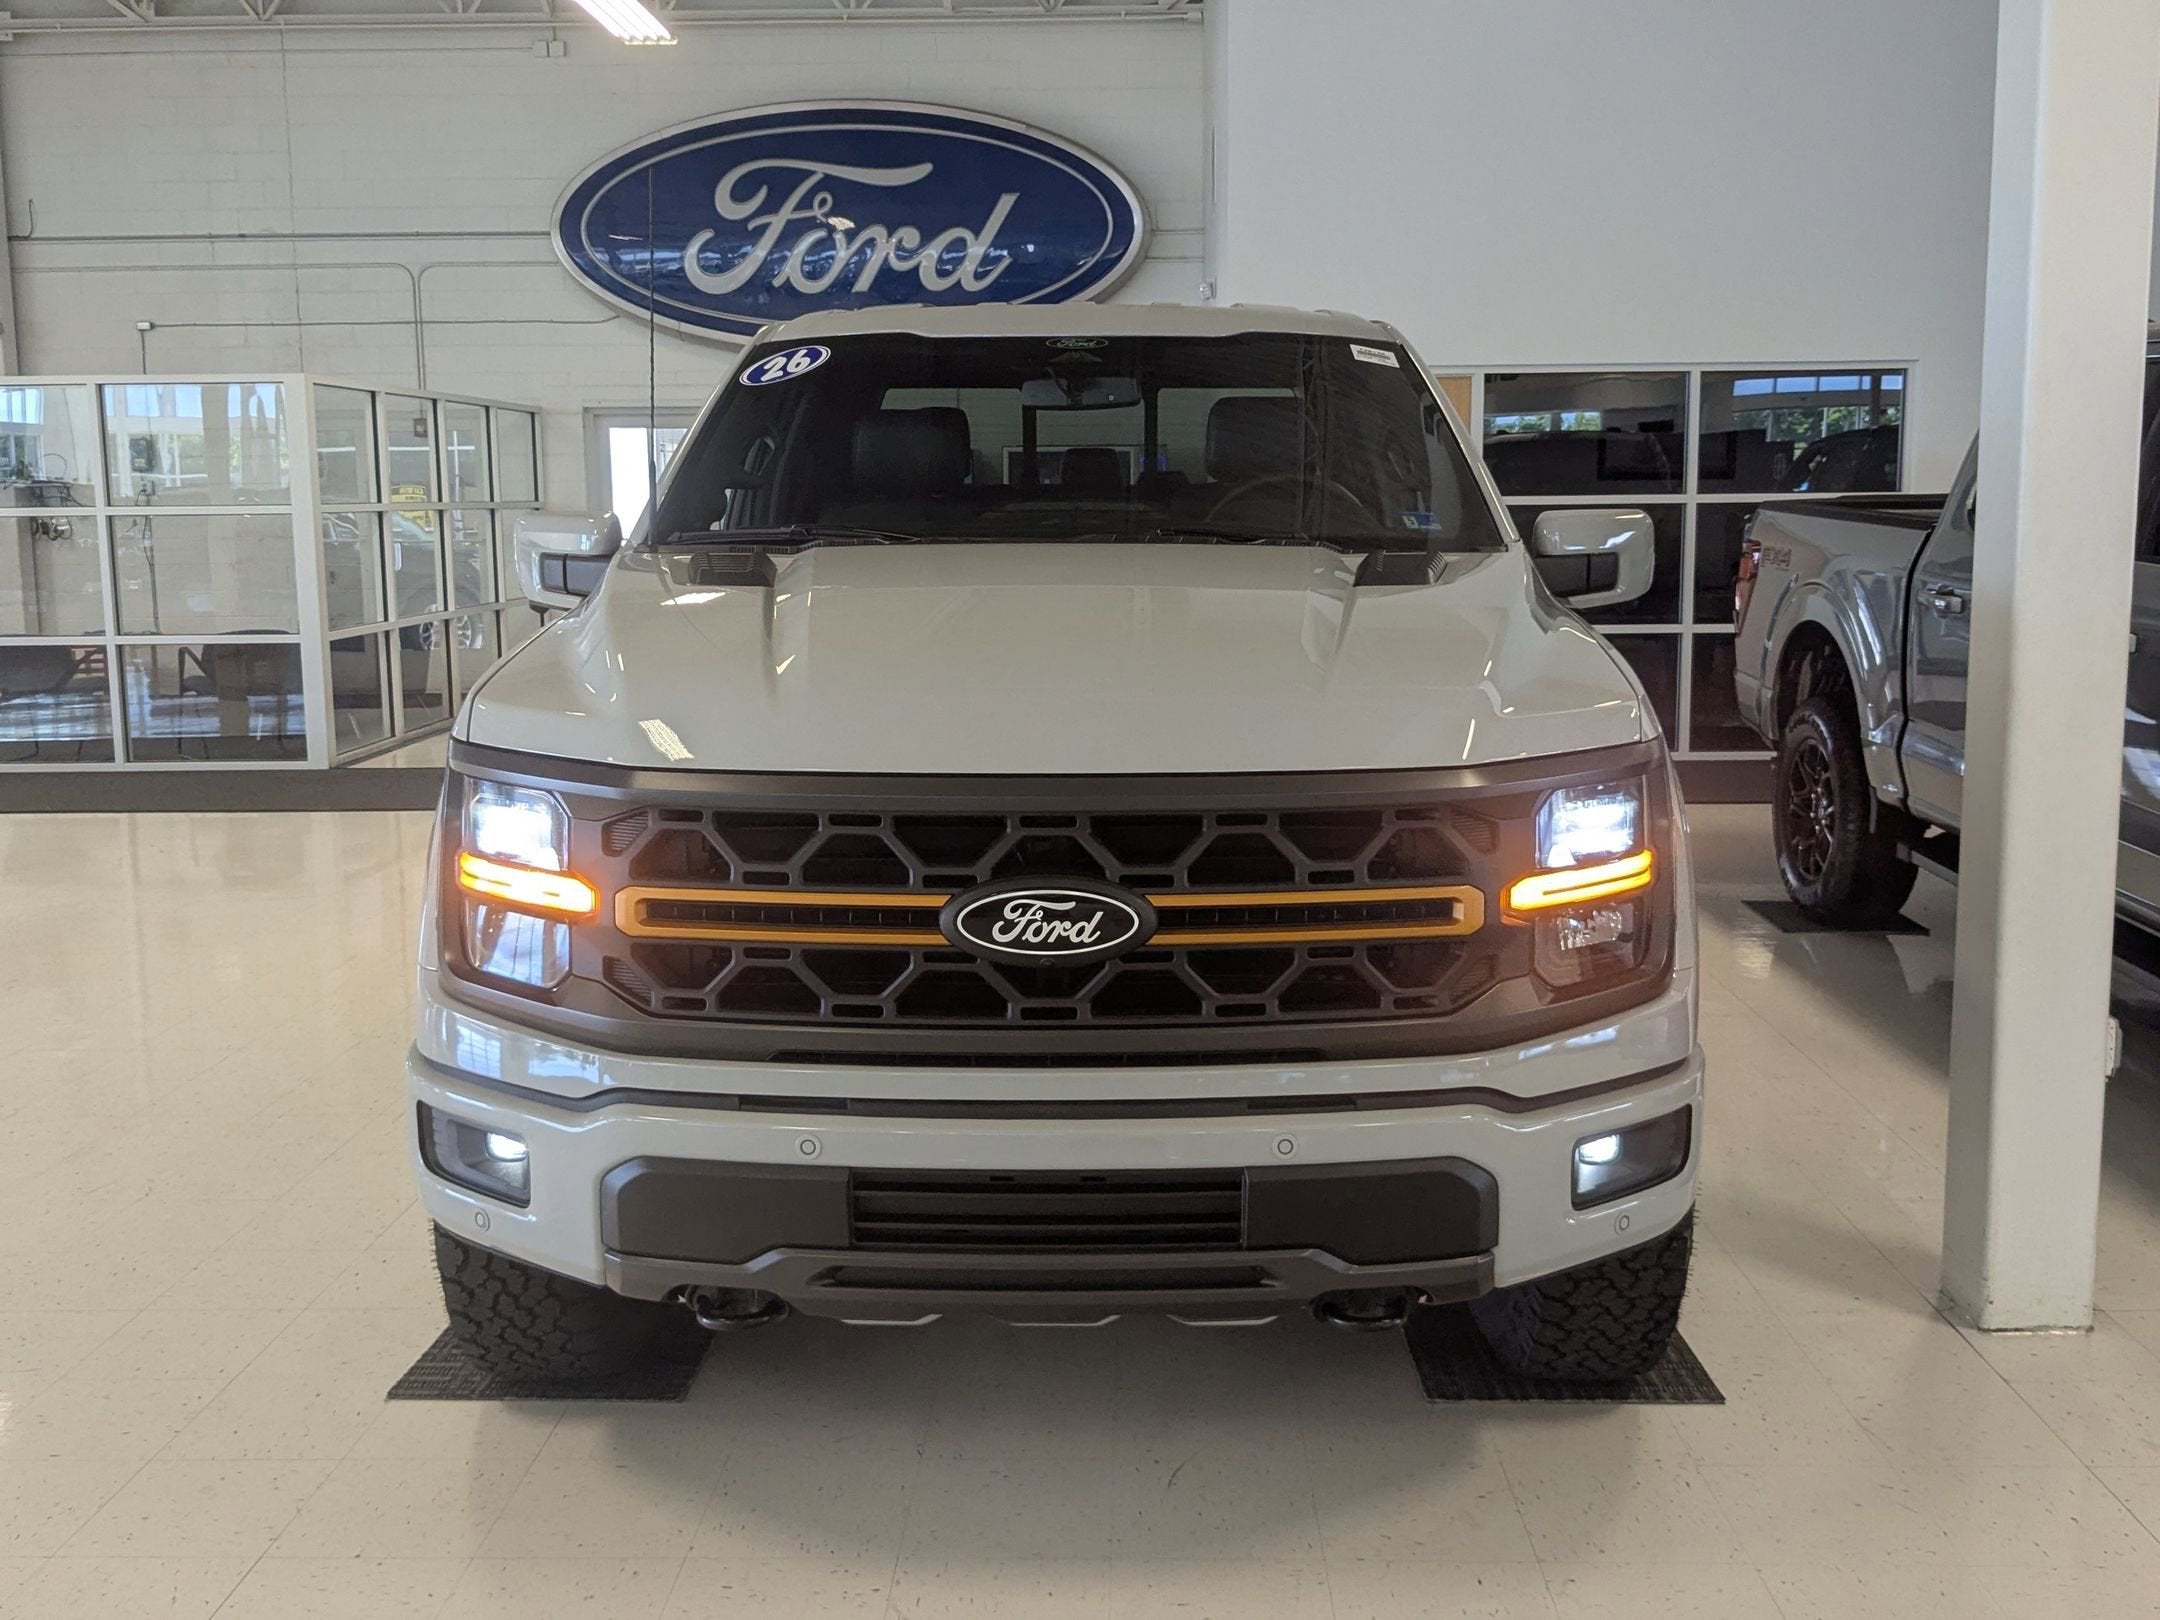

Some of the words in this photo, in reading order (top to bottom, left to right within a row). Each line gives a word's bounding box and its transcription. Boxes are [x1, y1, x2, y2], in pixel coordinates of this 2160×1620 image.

[684, 158, 1020, 295] Ford
[760, 348, 811, 382] 26
[991, 899, 1104, 943] Ford
